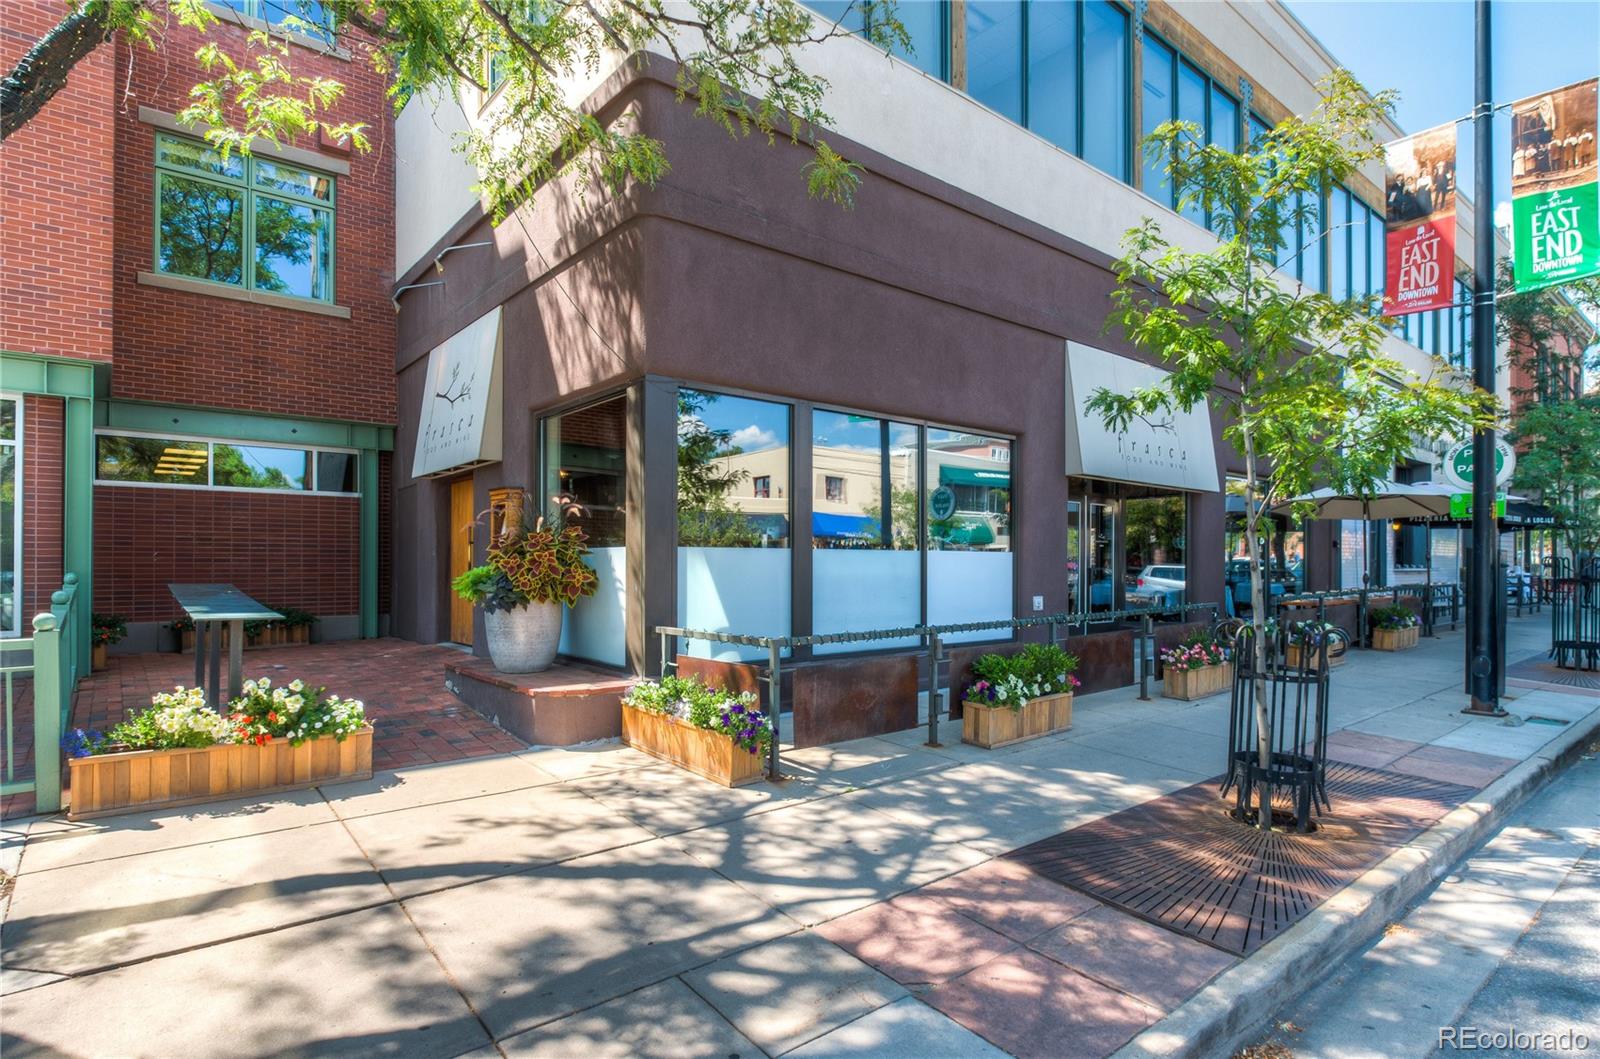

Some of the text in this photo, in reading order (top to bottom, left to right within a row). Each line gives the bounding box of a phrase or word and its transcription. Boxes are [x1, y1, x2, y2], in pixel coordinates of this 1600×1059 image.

[1531, 206, 1581, 237] EAST
[1402, 237, 1440, 268] EAST
[1532, 229, 1583, 264] END
[1399, 261, 1440, 292] END
[1532, 253, 1583, 273] DOWNTOWN
[1398, 285, 1439, 302] DOWNTOWN
[1118, 430, 1187, 461] frasca
